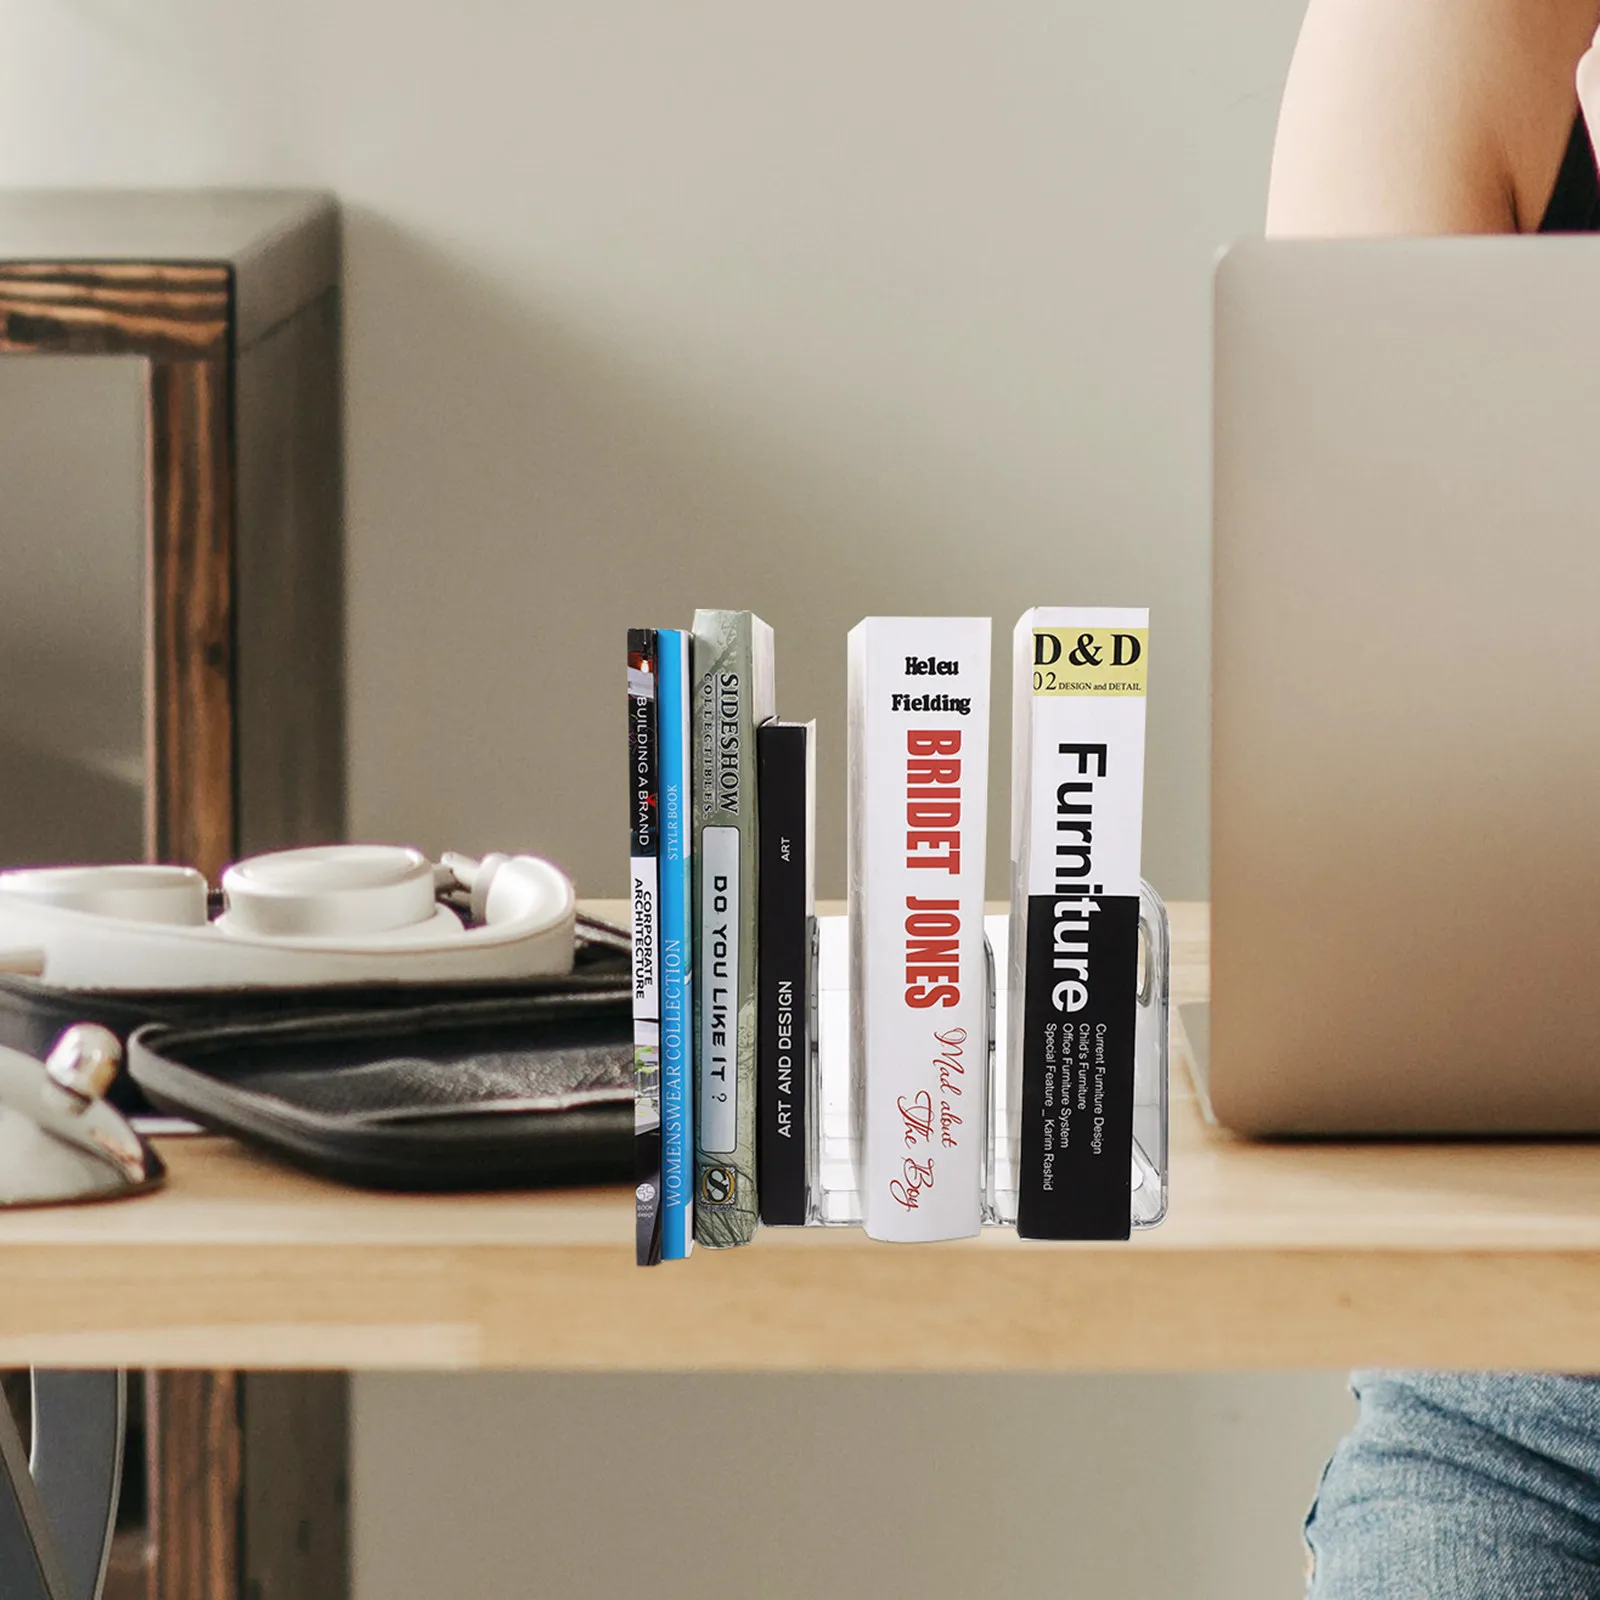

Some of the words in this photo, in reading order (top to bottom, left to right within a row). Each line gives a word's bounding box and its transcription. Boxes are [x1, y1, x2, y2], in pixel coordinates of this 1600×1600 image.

[1033, 633, 1062, 665] D
[1068, 633, 1103, 666] &
[1109, 634, 1141, 666] D
[1033, 671, 1057, 691] 02
[1058, 682, 1092, 691] DESIGN
[1093, 682, 1108, 691] and
[1109, 683, 1141, 691] DETAIL
[892, 694, 971, 715] Fielding
[637, 697, 649, 774] BUILDING
[720, 673, 739, 815] SIDESHOW
[638, 776, 648, 787] A
[668, 784, 678, 819] BOOK
[906, 730, 962, 874] BRIDET
[638, 791, 649, 846] BRAND
[781, 837, 790, 862] ART
[714, 876, 728, 913] DO
[1052, 743, 1107, 1013] Furniture
[634, 878, 644, 999] ARCHITECTURE
[643, 891, 653, 985] CORPORATE
[712, 924, 728, 978] YOU
[905, 896, 961, 1009] JONES
[665, 939, 680, 1060] COLLECTION
[711, 988, 728, 1047] LIKE
[779, 981, 792, 1050] DESIGN
[1044, 1023, 1057, 1063] Special
[1062, 1023, 1074, 1055] Office
[1078, 1023, 1090, 1060] Child's
[1095, 1023, 1107, 1064] Current
[711, 1057, 727, 1081] IT
[778, 1056, 792, 1094] AND
[932, 1027, 967, 1096] Mad
[1061, 1057, 1073, 1105] Furniture
[711, 1093, 727, 1104] ?
[1044, 1065, 1057, 1107] Feature
[1077, 1062, 1089, 1111] Furniture
[1094, 1065, 1106, 1114] Furniture
[666, 1065, 682, 1208] WOMENSWEAR
[778, 1100, 792, 1138] ART
[897, 1090, 935, 1149] The
[1044, 1119, 1055, 1151] Karim
[1058, 1107, 1072, 1149] System
[1090, 1117, 1105, 1154] Design
[890, 1157, 935, 1212] Boy
[1043, 1153, 1055, 1191] Rashid
